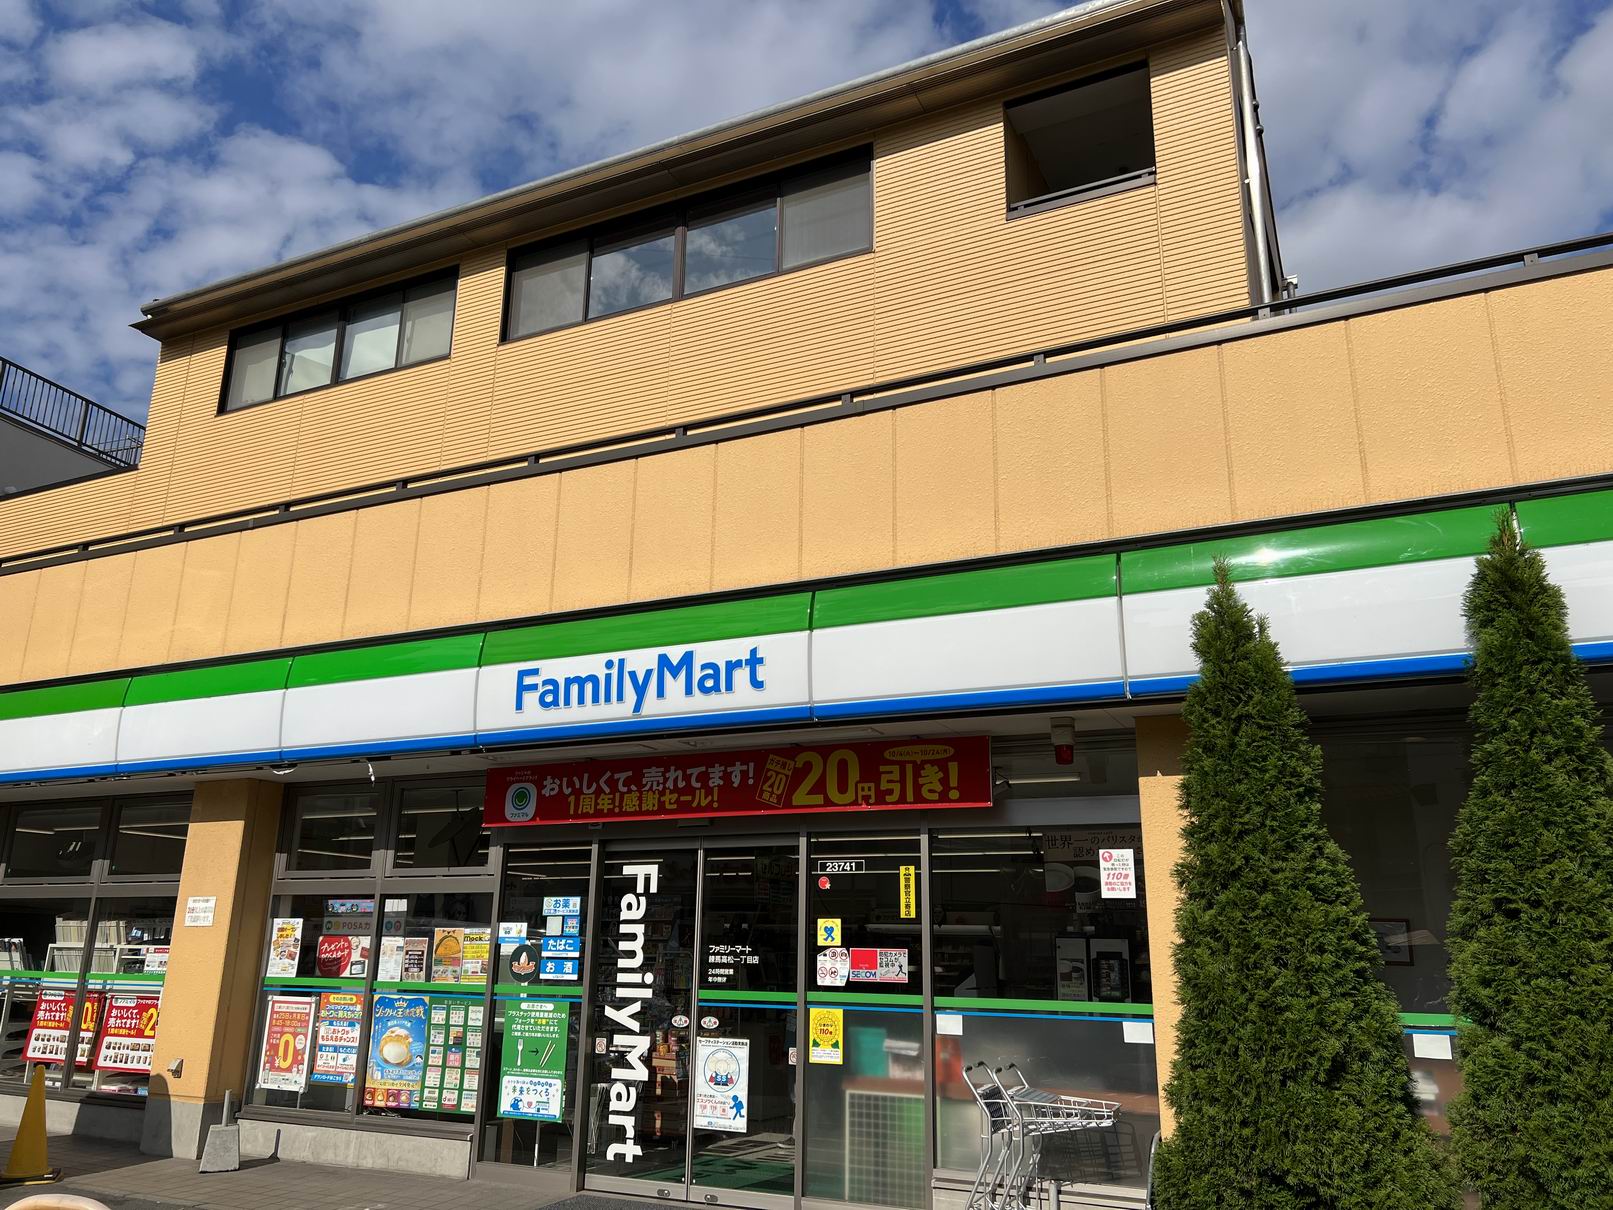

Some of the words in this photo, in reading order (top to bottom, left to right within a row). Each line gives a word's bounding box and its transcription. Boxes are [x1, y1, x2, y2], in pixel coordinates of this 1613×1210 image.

[515, 646, 766, 714] FamilyMart
[762, 770, 787, 795] 20
[761, 791, 778, 804] 商品
[826, 862, 856, 872] 23741
[1106, 872, 1130, 881] 110番
[553, 898, 571, 909] お薬
[548, 939, 574, 950] たばこ
[709, 945, 753, 954] ファミリーマート
[708, 955, 760, 964] 練馬高松一丁目店
[851, 970, 877, 978] SECOM
[605, 864, 660, 1163] FamilyMart
[512, 1085, 549, 1098] 未来をつくる
